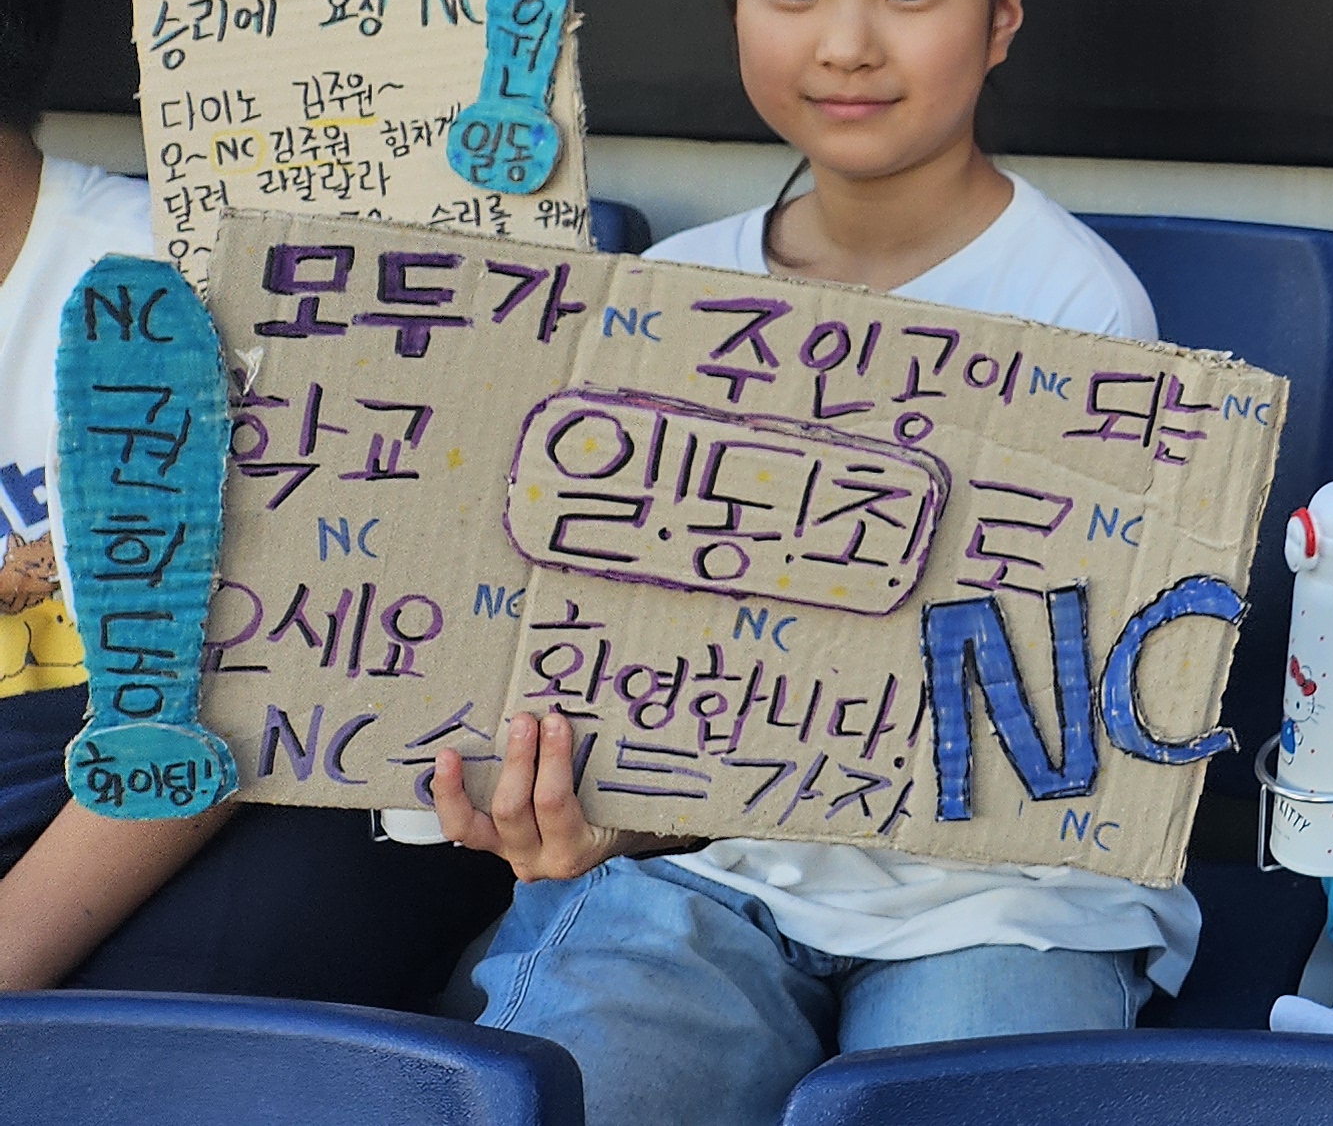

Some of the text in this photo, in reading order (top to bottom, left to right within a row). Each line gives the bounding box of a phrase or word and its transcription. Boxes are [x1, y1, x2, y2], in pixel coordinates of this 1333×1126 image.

[161, 89, 261, 131] 다이노
[215, 137, 254, 165] NC
[269, 124, 354, 166] 김주원
[461, 120, 533, 185] 일동
[163, 180, 229, 232] 달려
[537, 199, 587, 234] 위해
[85, 285, 174, 342] NC
[254, 243, 1272, 466] 모두가 NC 주인공이 NC 되는 NC
[228, 369, 433, 510] 학교
[957, 479, 1075, 600] 로
[1086, 504, 1144, 547] NC
[86, 384, 192, 720] 권희동
[318, 517, 380, 561] NC
[201, 577, 444, 679] 오세요
[472, 582, 527, 620] NC
[732, 605, 800, 654] NC
[920, 574, 1252, 823] NC
[257, 702, 385, 787] NC
[1060, 808, 1120, 852] NC
